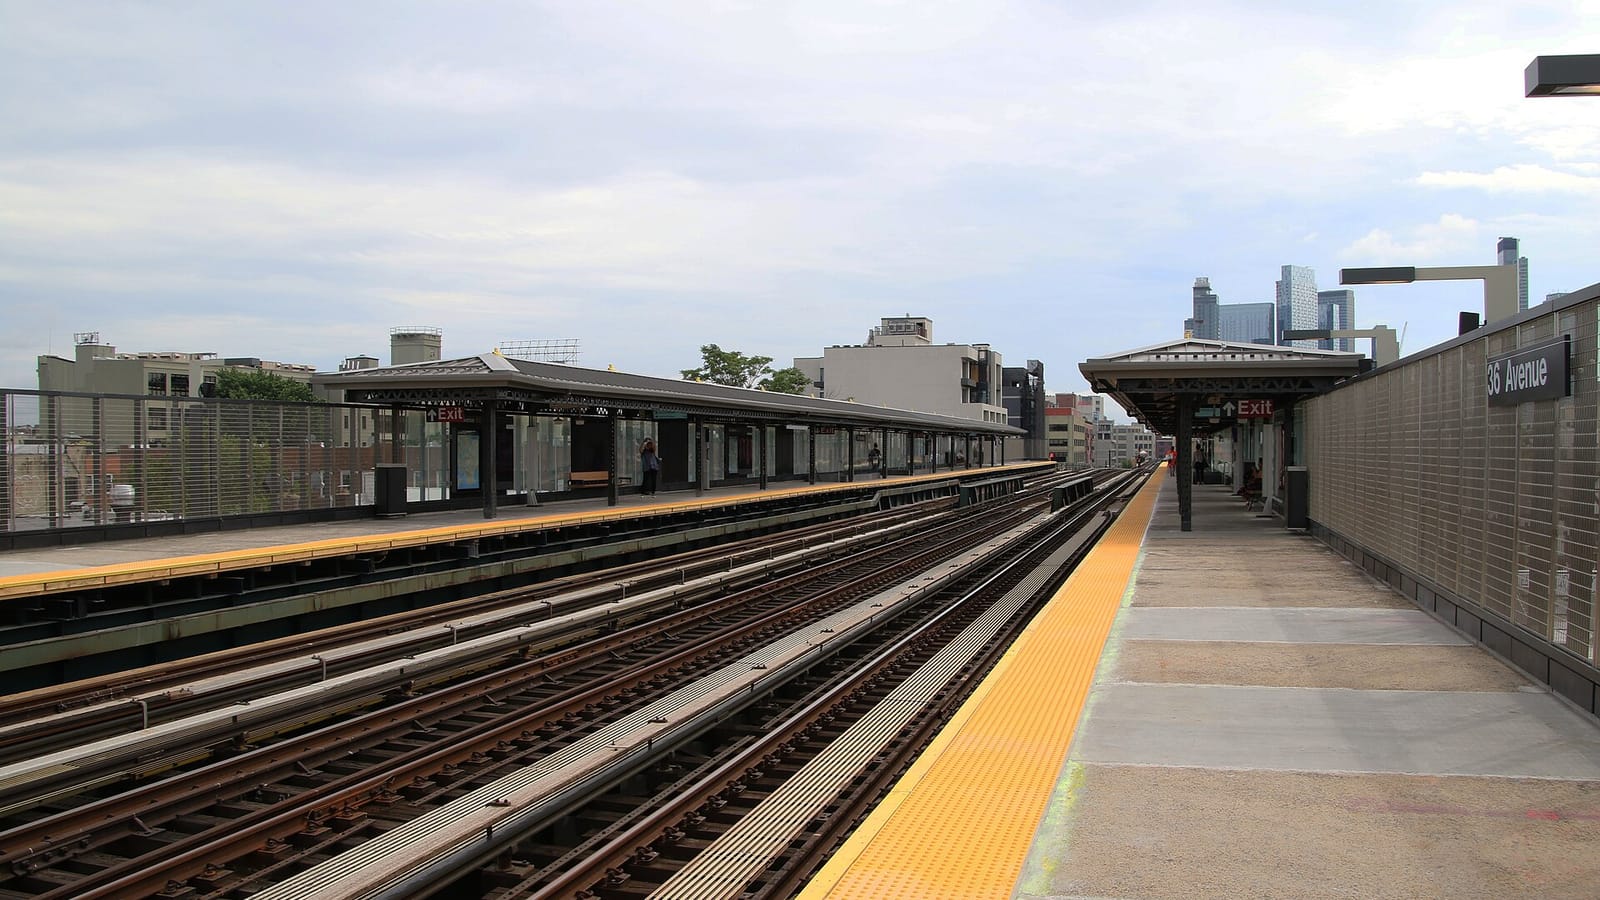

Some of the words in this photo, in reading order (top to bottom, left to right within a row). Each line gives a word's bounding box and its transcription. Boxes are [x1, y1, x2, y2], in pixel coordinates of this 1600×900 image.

[1487, 362, 1500, 396] 36
[1505, 358, 1547, 392] Avenue
[438, 407, 463, 420] Exit
[1238, 400, 1272, 415] Exit
